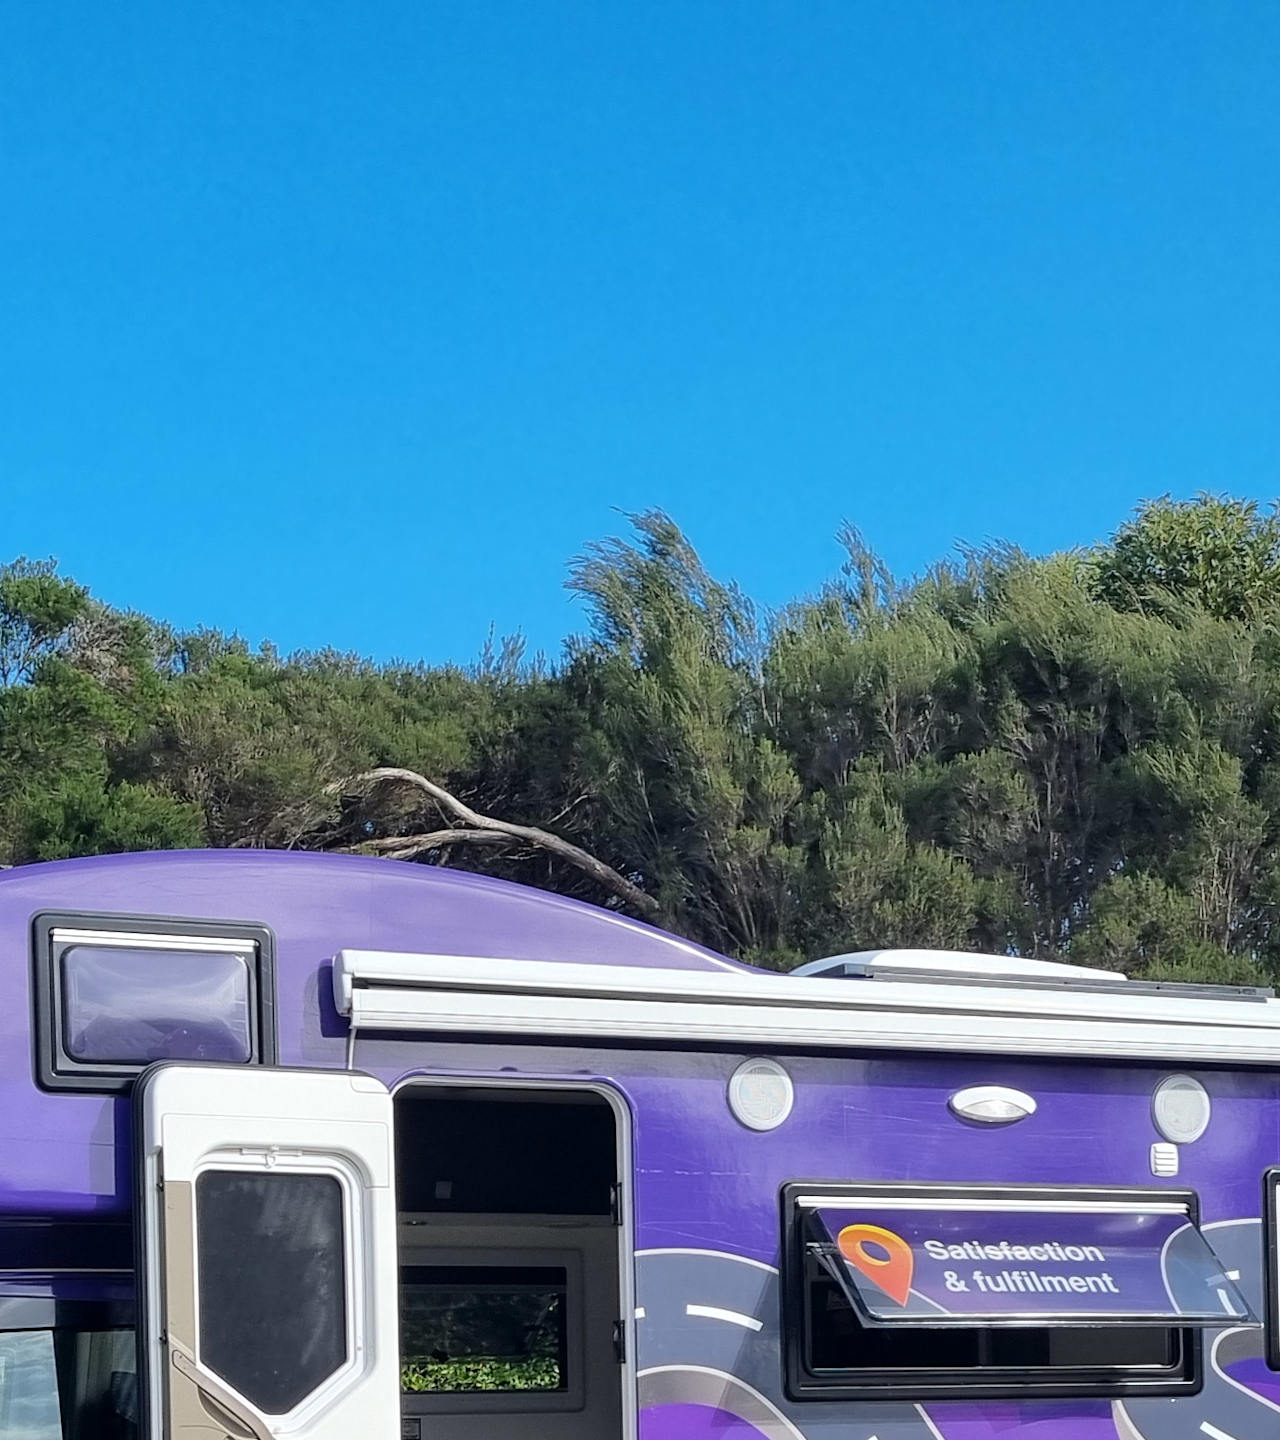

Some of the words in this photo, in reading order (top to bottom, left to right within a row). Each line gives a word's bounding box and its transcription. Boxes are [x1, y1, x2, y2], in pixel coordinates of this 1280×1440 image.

[923, 1239, 1105, 1262] Satisfaction
[944, 1270, 970, 1292] &
[973, 1270, 1120, 1293] fulfilment
